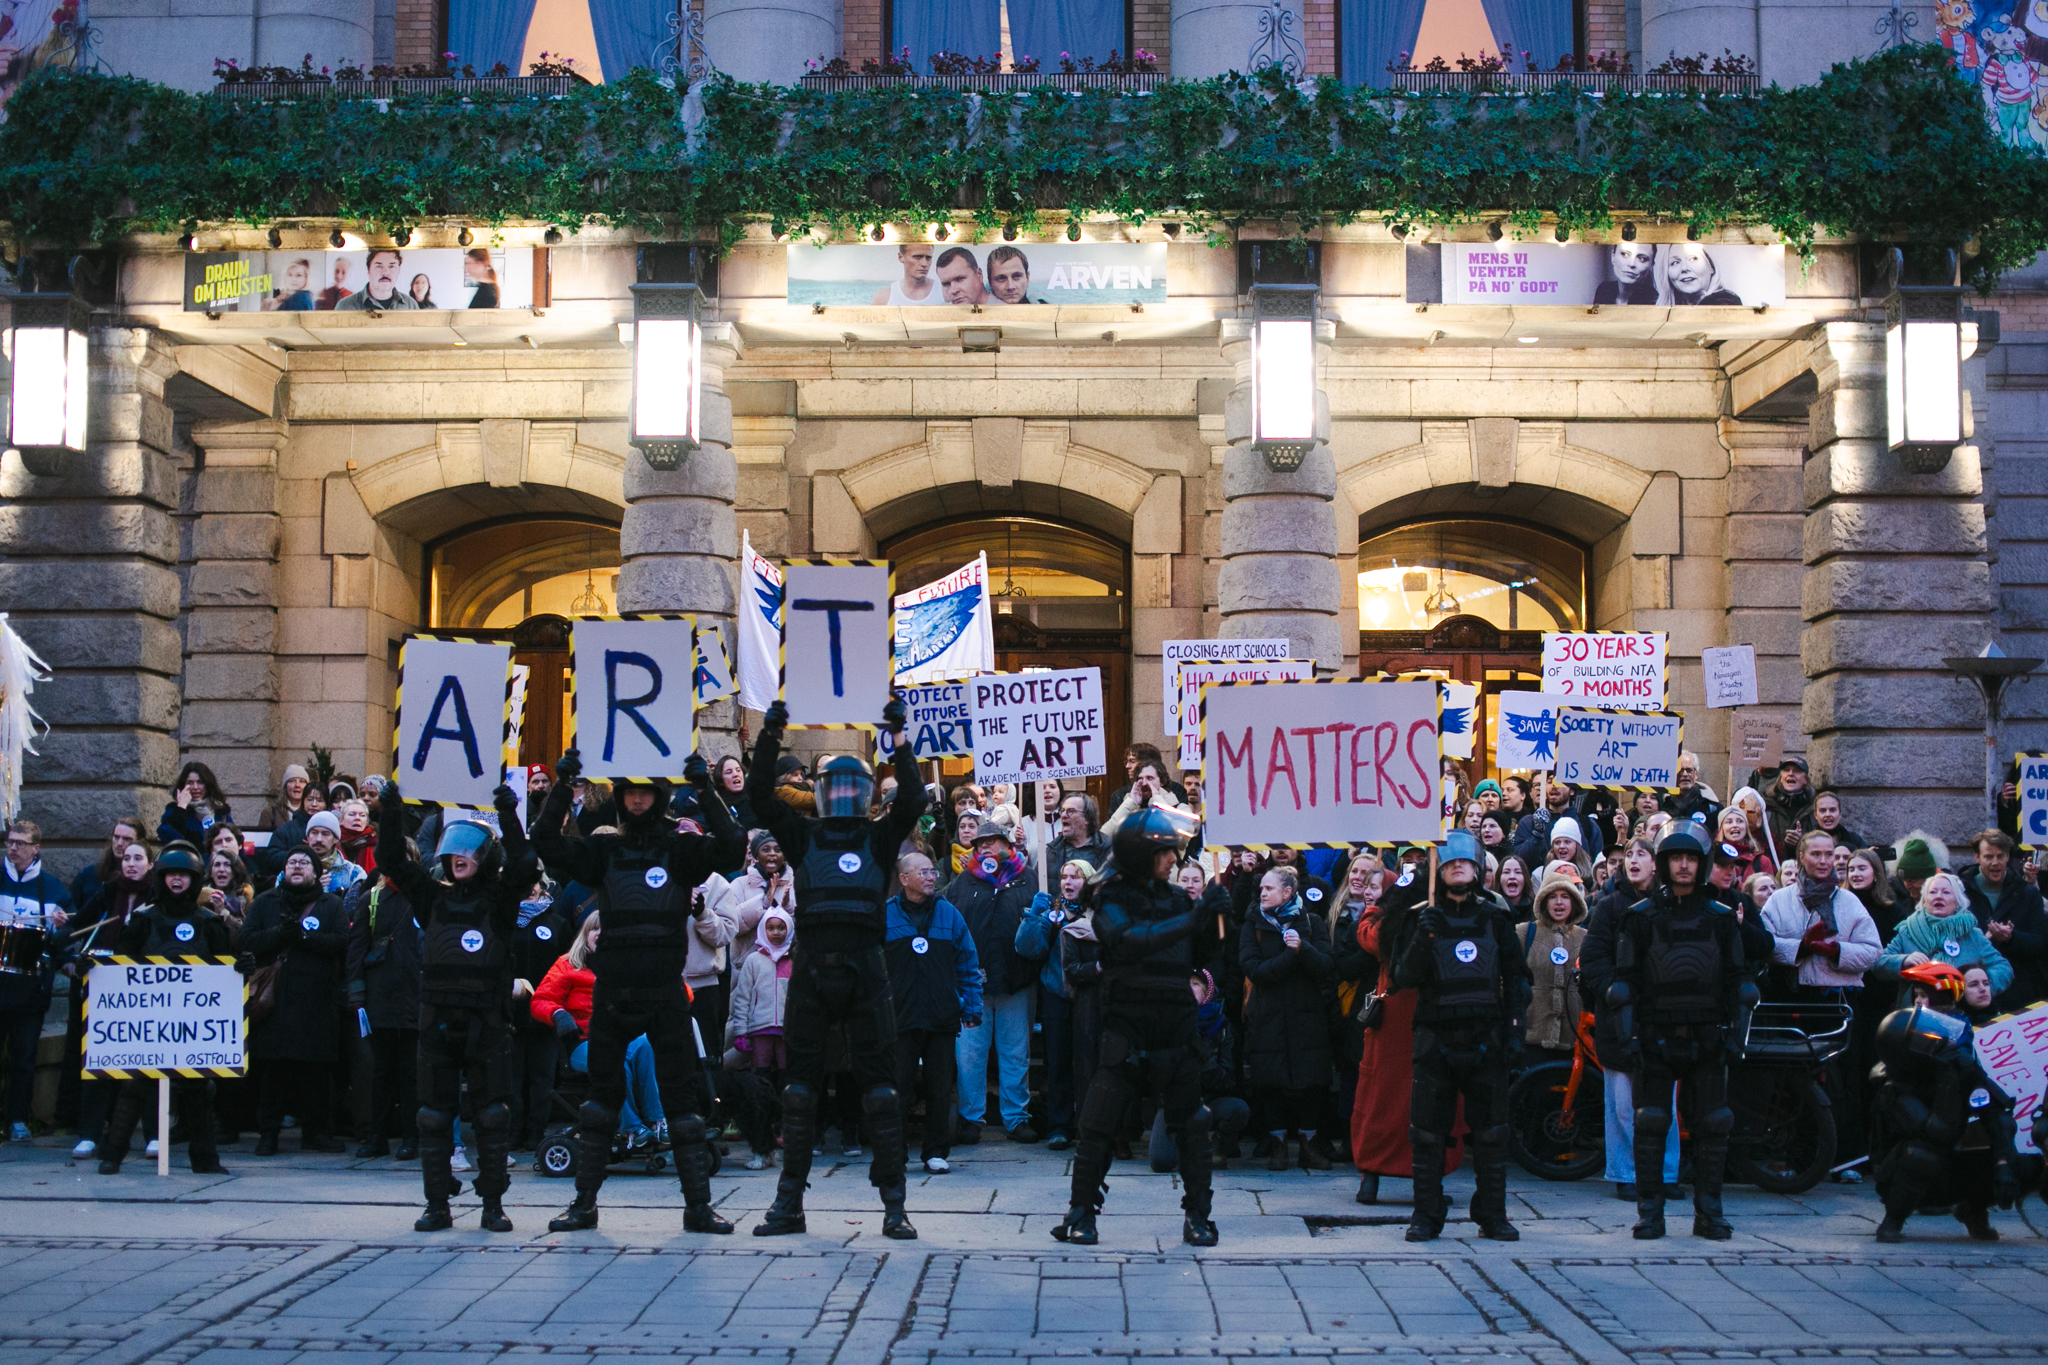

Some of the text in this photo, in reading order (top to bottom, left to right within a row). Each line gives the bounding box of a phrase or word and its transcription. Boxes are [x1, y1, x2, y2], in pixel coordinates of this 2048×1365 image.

[1468, 253, 1528, 265] MENS VI
[205, 259, 250, 284] DRAUM
[1047, 265, 1152, 290] ARVEN
[1468, 266, 1527, 278] VENTER
[194, 274, 272, 304] OM HAUSTEN
[1469, 278, 1558, 293] PÅ NO' GODT
[918, 565, 981, 603] FUTURE
[792, 598, 874, 698] T
[1167, 644, 1287, 659] CLOSING ART SCHOOLS
[1554, 636, 1655, 662] 30 YEARS
[1548, 664, 1657, 677] OF BUILDING NTA
[895, 686, 963, 706] ROTECT
[977, 676, 1088, 709] PROTECT
[1561, 678, 1652, 697] 2 MONTHS
[602, 649, 671, 763] R
[914, 703, 969, 722] FUTURE
[412, 675, 484, 779] A
[978, 708, 1099, 737] THE FUTURE
[1518, 719, 1550, 734] SAVE
[1559, 715, 1674, 737] SOCIETY WITHOUT
[913, 719, 973, 756] ART
[1598, 738, 1638, 759] ART
[982, 735, 1091, 772] OF ART
[977, 765, 1105, 786] AKADEMI FOR SCENEKUNST
[1216, 719, 1436, 816] MATTERS
[1565, 761, 1670, 783] IS SLOW DEATH
[126, 966, 193, 986] REDDE
[96, 991, 221, 1009] AKADEMI FOR
[93, 1018, 237, 1045] SCENEKUNST!
[89, 1052, 242, 1067] HØGSKOLEN I ØSTFOLD
